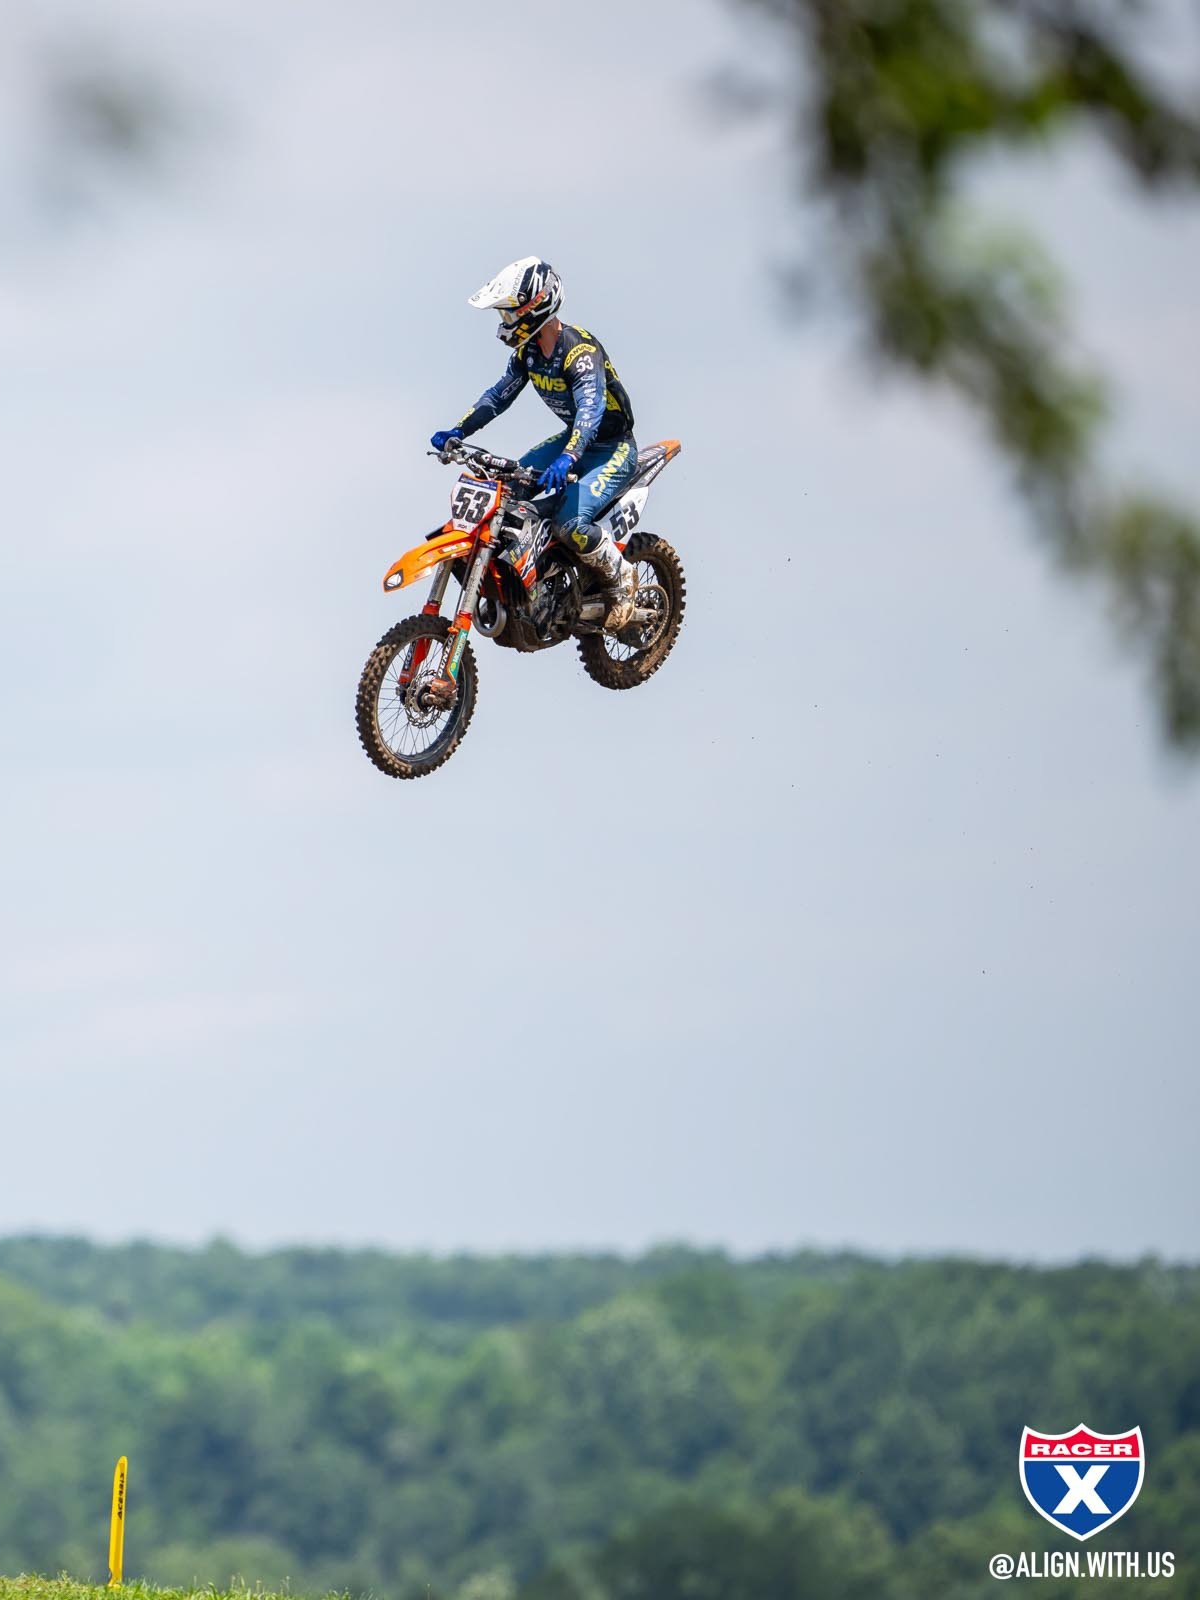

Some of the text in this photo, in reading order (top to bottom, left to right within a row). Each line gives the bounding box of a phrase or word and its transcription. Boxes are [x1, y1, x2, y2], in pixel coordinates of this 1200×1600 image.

[576, 355, 594, 373] 53
[576, 420, 593, 428] FIST
[644, 459, 665, 481] DUNLOP
[452, 486, 492, 524] 53
[609, 500, 640, 542] 53
